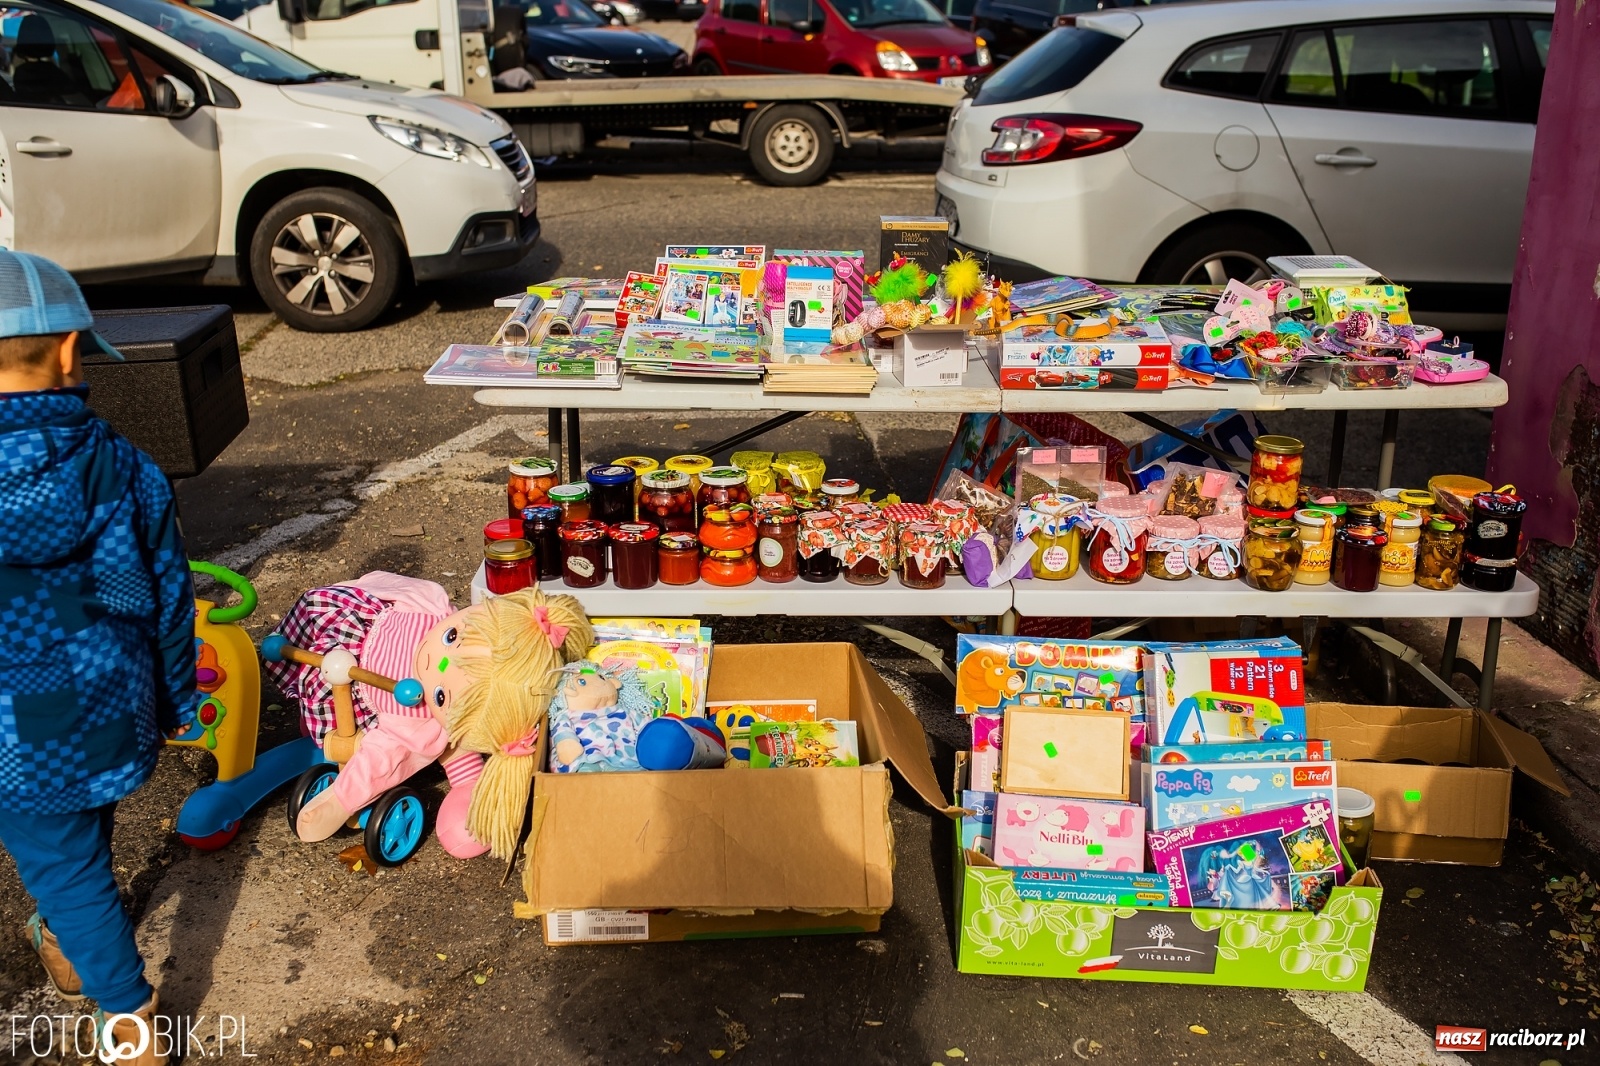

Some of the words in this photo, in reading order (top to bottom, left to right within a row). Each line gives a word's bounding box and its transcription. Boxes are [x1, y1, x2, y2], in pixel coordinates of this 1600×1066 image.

[1016, 641, 1146, 672] DOMINO
[1235, 665, 1244, 679] 12
[1246, 661, 1254, 691] Pattern
[1254, 665, 1266, 680] 21
[1273, 664, 1284, 673] 3
[769, 725, 785, 767] Tierkinder
[980, 754, 989, 788] PUZZLE
[1307, 769, 1331, 781] Trefl
[1156, 771, 1192, 794] Peppa
[1193, 771, 1212, 793] Pig
[1039, 830, 1070, 845] Nelli
[1148, 825, 1196, 852] Disney
[1021, 870, 1077, 882] LITERY
[1169, 856, 1185, 889] puzzle
[1016, 885, 1042, 901] iszę
[1057, 889, 1117, 905] zmazuję
[986, 959, 1045, 967] www.vita-land.pl
[1138, 952, 1191, 962] VitaLand
